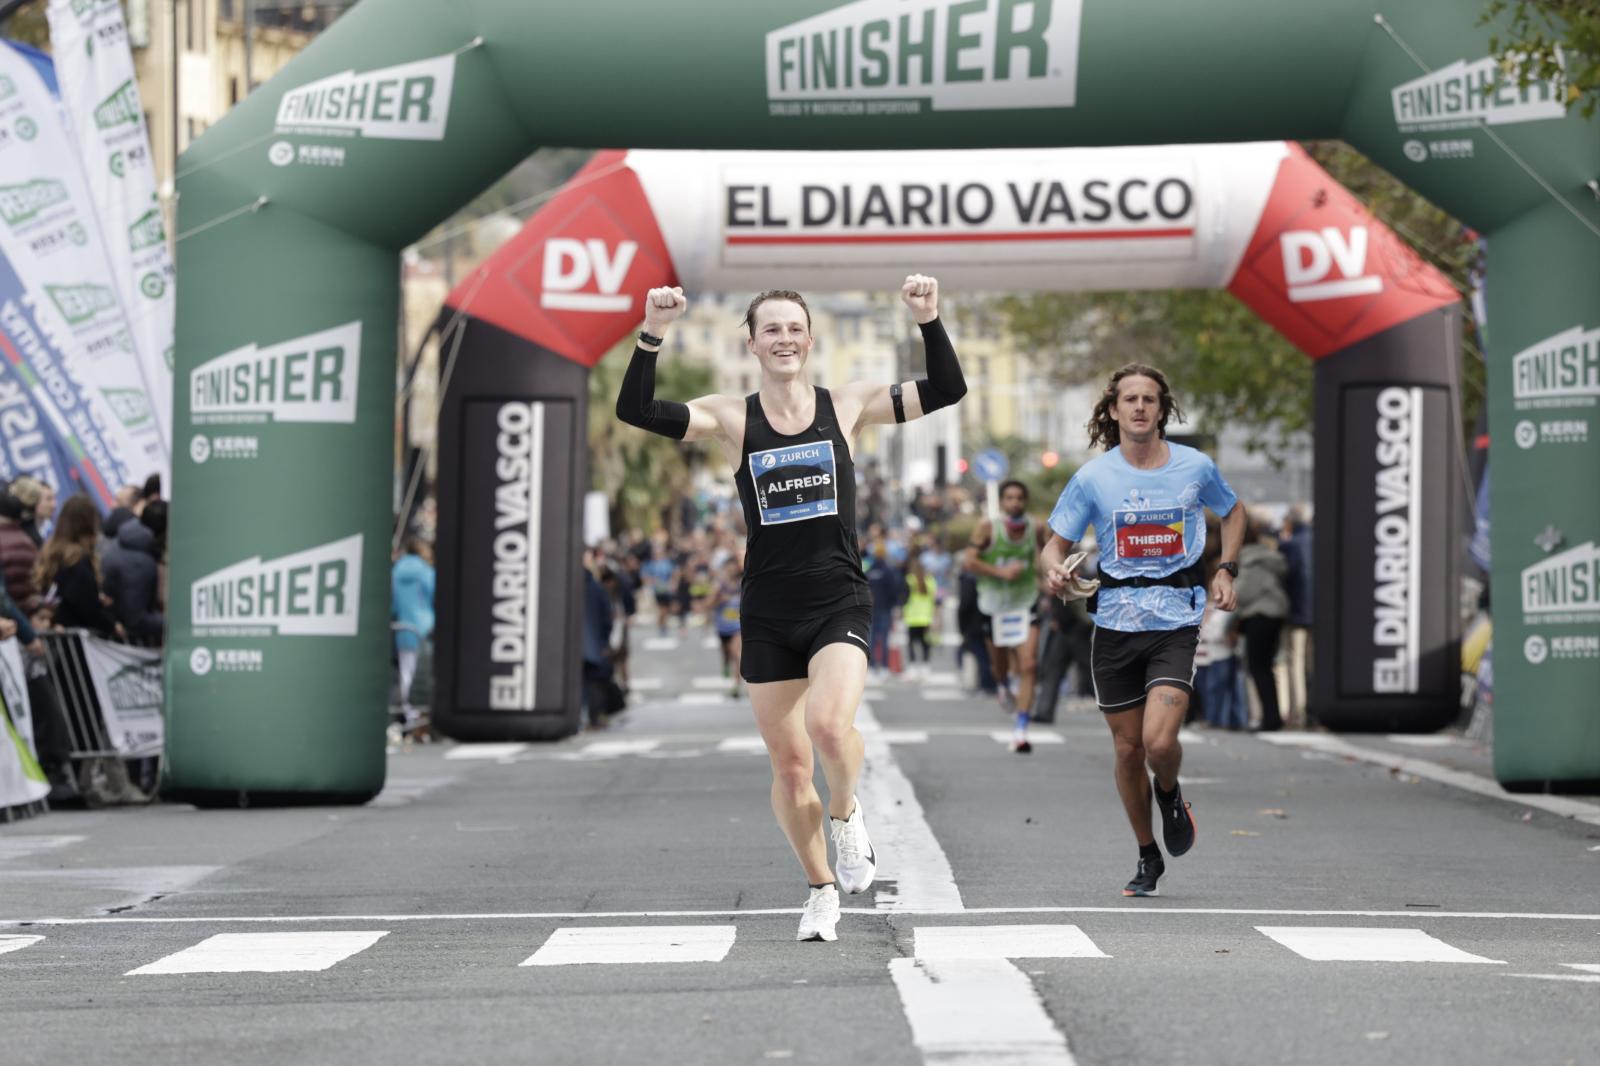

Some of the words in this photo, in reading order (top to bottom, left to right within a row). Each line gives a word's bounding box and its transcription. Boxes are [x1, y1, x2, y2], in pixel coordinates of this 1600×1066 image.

[779, 0, 1052, 91] FINISHER
[284, 75, 435, 123] FINISHER
[726, 185, 788, 227] EL
[801, 184, 994, 227] DIARIO
[1008, 178, 1194, 224] VASCO
[542, 237, 638, 294] DV
[1280, 226, 1367, 285] DV
[195, 346, 344, 408] FINISHER
[494, 401, 532, 530] VASCO
[780, 449, 819, 463] ZURICH
[1375, 387, 1410, 514] VASCO
[768, 473, 831, 494] ALFREDS
[796, 494, 804, 503] 5
[1127, 533, 1178, 545] THIERRY
[1140, 512, 1174, 521] ZURICH
[196, 559, 348, 619] FINISHER
[491, 530, 529, 663] DIARIO
[1374, 514, 1409, 646] DIARIO
[489, 664, 525, 711] EL
[1373, 647, 1407, 694] EL
